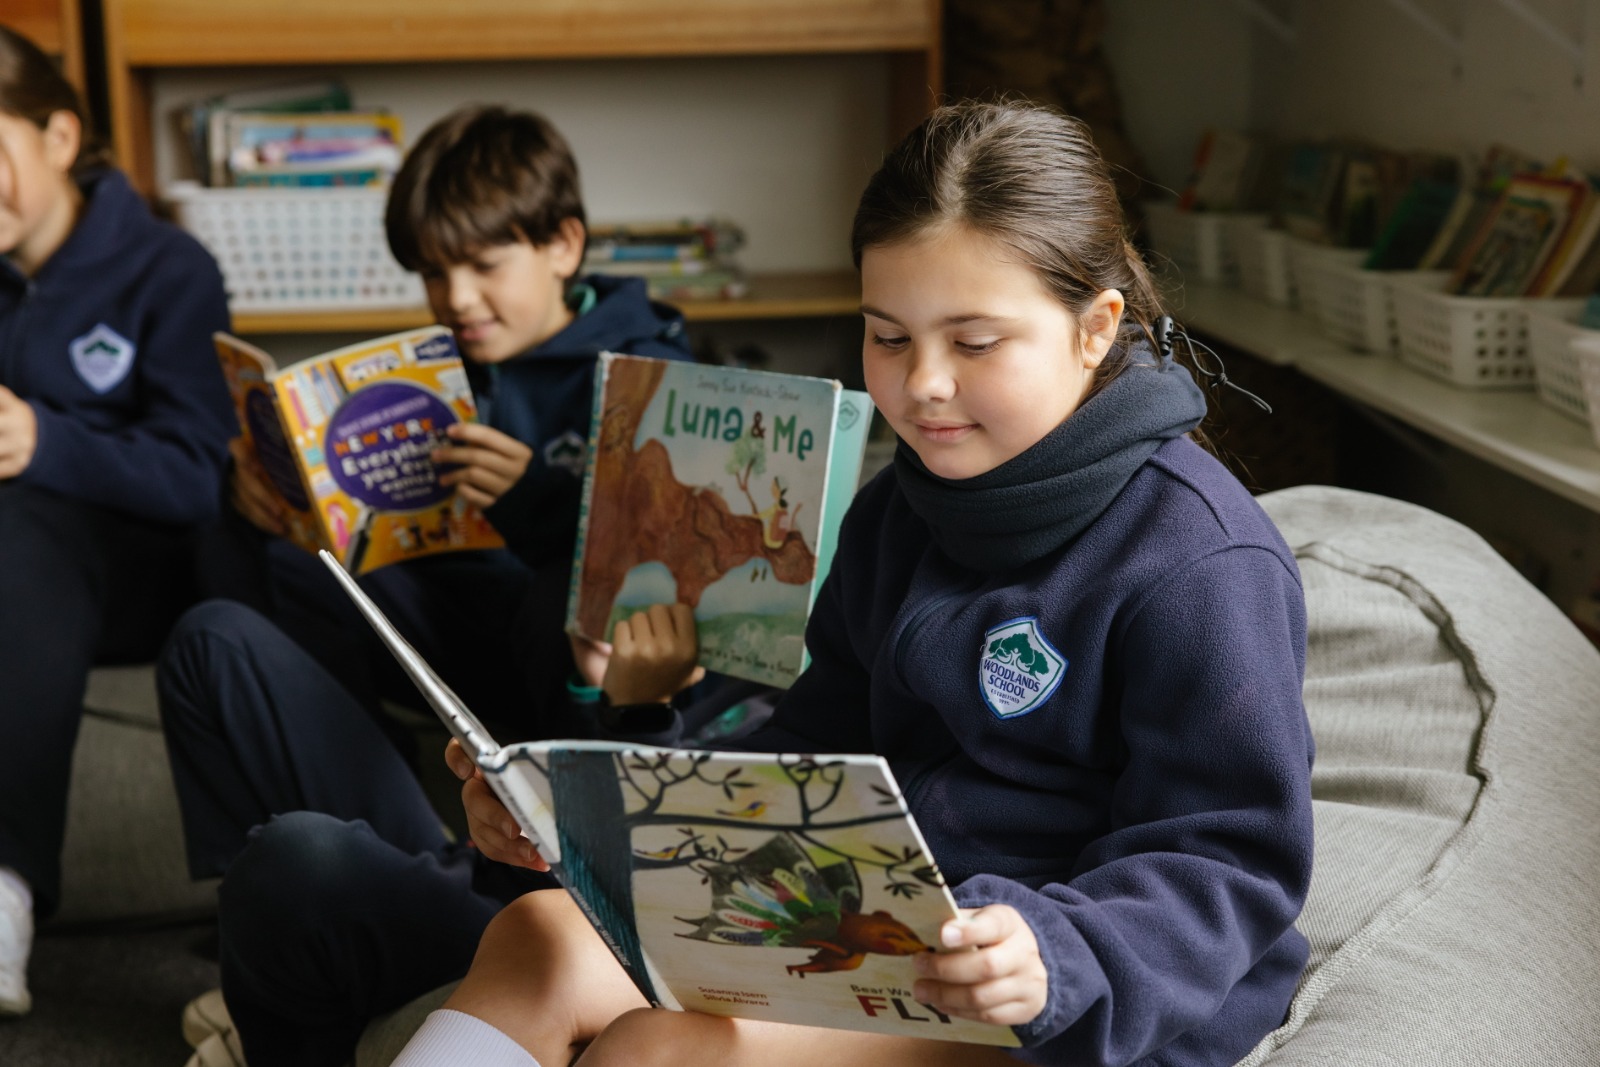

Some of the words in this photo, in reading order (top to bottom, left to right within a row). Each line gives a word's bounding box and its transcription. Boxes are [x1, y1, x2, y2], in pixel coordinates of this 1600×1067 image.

[333, 430, 379, 457] NEW
[380, 418, 433, 443] YORK
[663, 389, 743, 442] Luna
[751, 411, 766, 439] &
[773, 415, 813, 461] Me
[361, 466, 398, 490] you
[983, 659, 1041, 692] WOODLANDS
[988, 675, 1026, 699] SCHOOL
[698, 986, 740, 997] Susanna
[850, 984, 883, 995] Bear
[856, 995, 952, 1024] FLY
